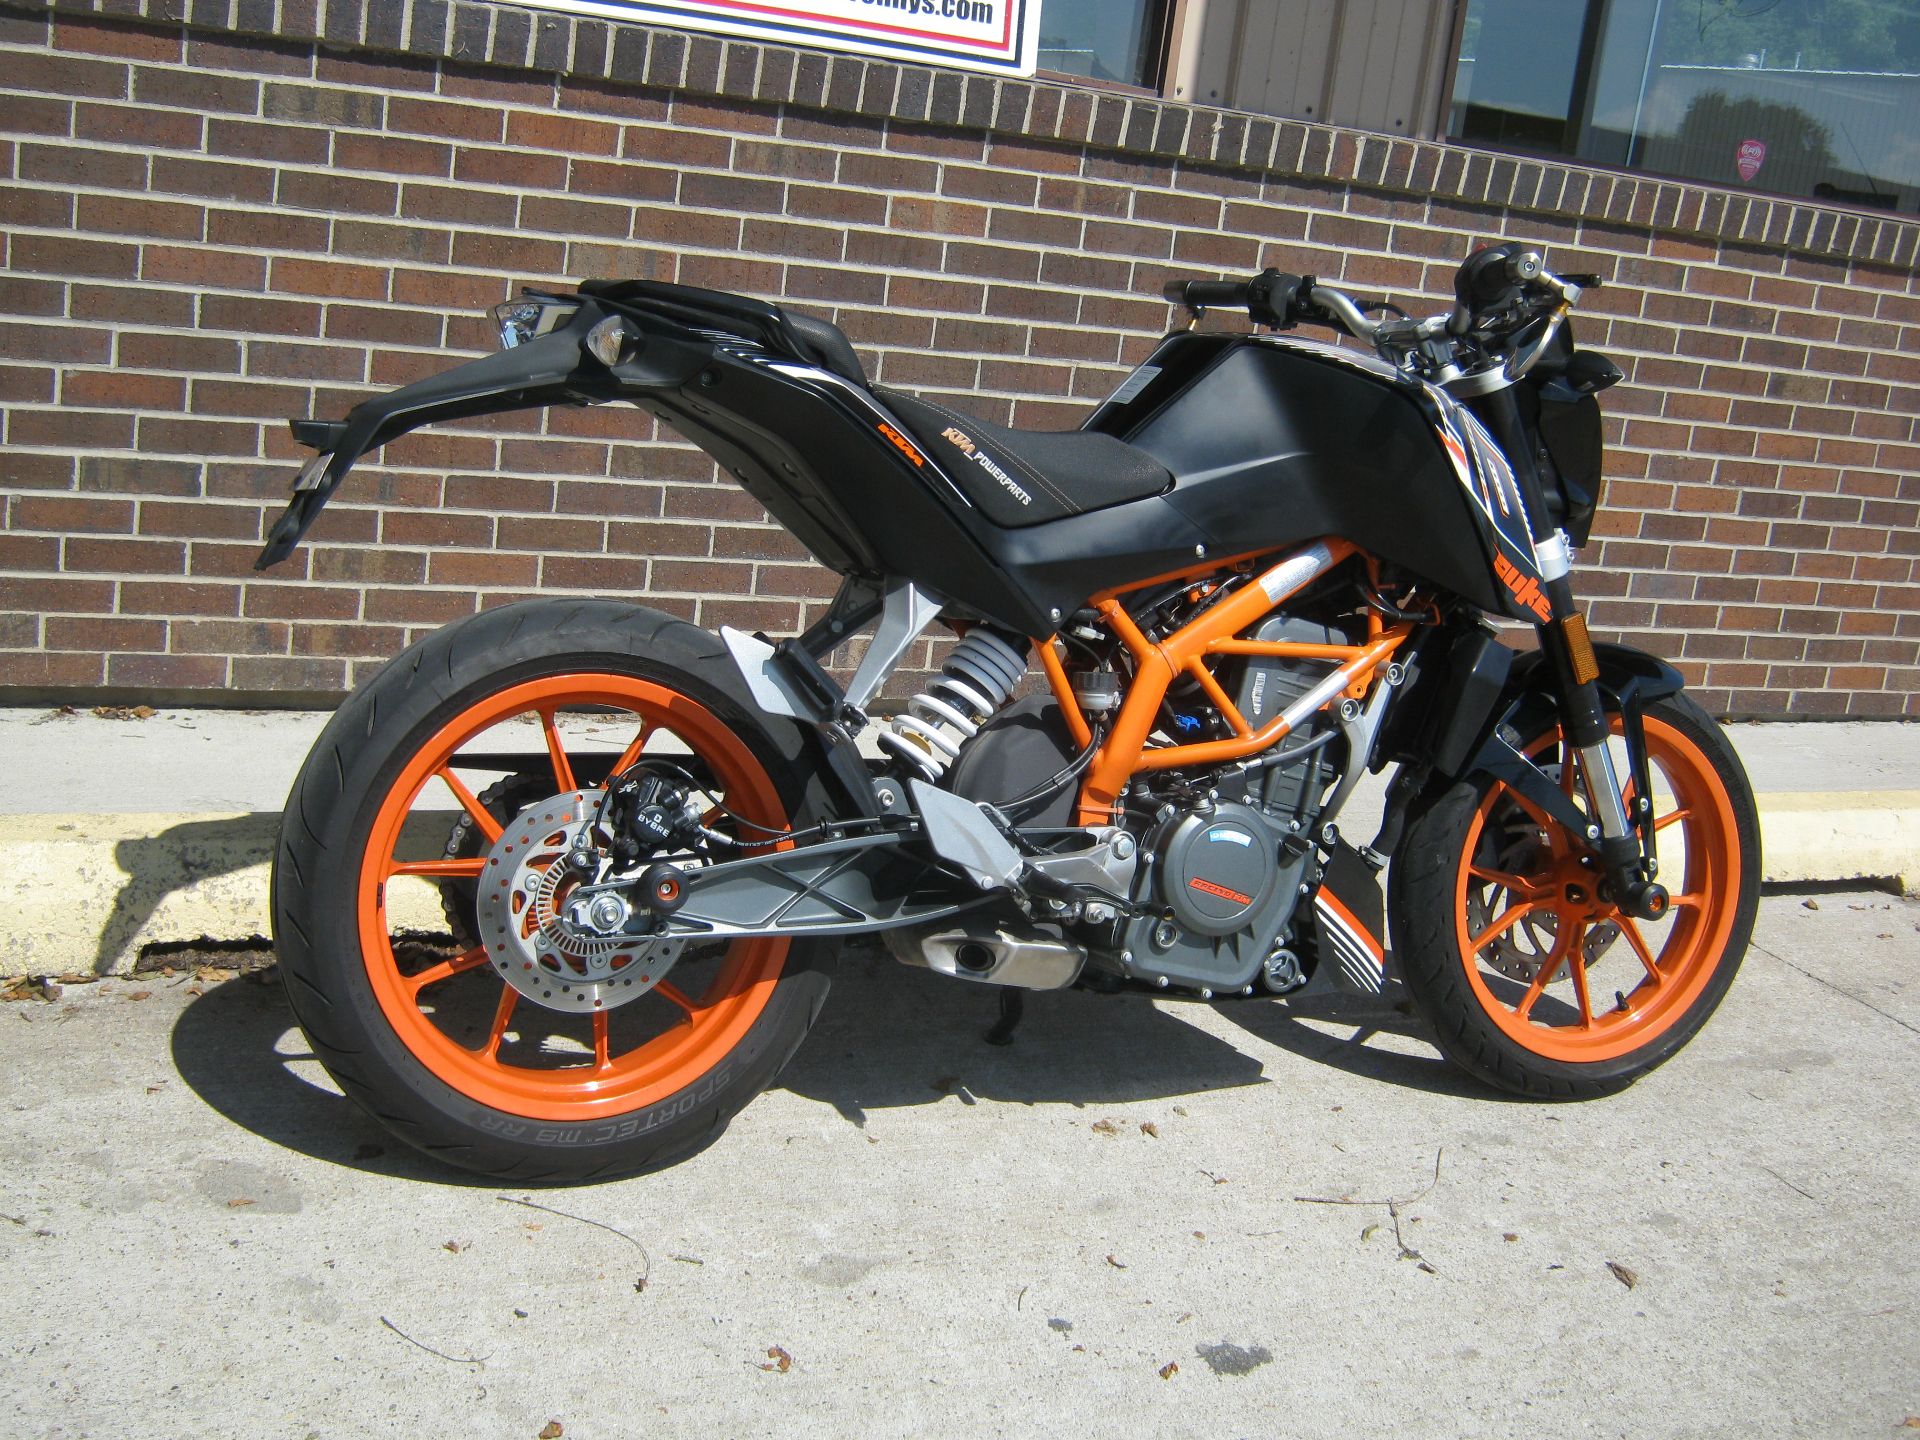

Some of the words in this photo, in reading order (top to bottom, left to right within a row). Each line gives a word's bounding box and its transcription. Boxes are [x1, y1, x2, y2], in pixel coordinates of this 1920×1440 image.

[877, 423, 924, 468] KTM
[940, 427, 976, 457] KTM
[973, 451, 1033, 506] POWERPARTS
[637, 814, 670, 838] BYBRE
[479, 1116, 526, 1137] RR
[594, 1069, 731, 1142] SPORTEC
